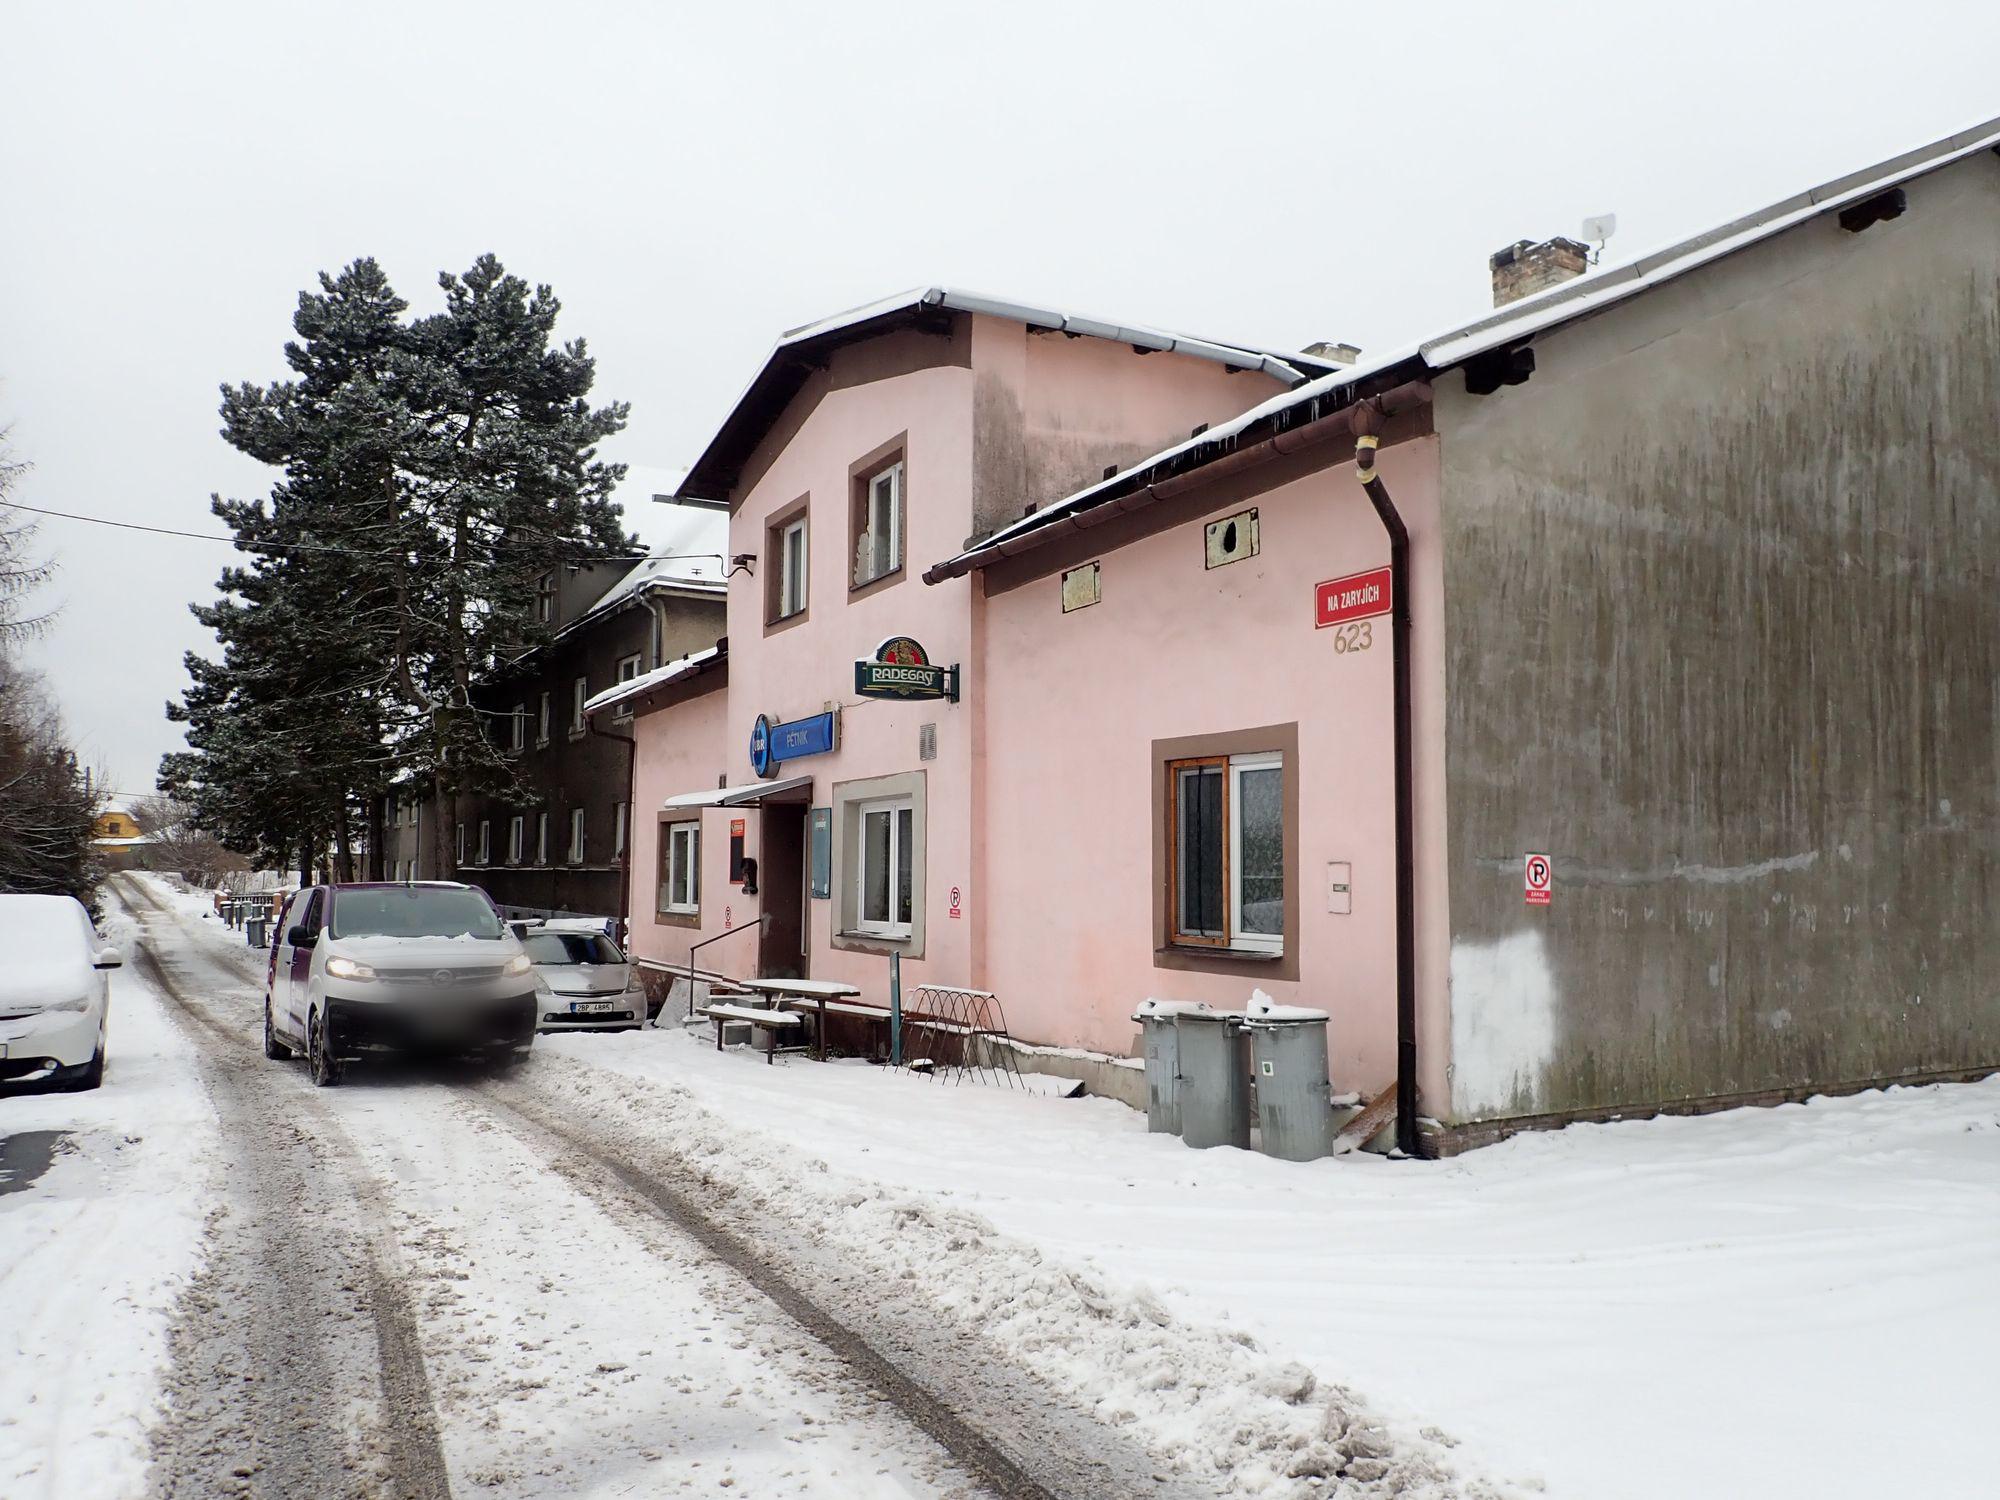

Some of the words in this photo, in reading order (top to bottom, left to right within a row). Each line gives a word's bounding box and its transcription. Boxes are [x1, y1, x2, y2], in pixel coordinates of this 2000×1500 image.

[1327, 594, 1339, 612] NA
[1341, 583, 1380, 609] ZARYJÍCH
[1334, 621, 1373, 655] 623
[872, 667, 935, 687] RADEGAST
